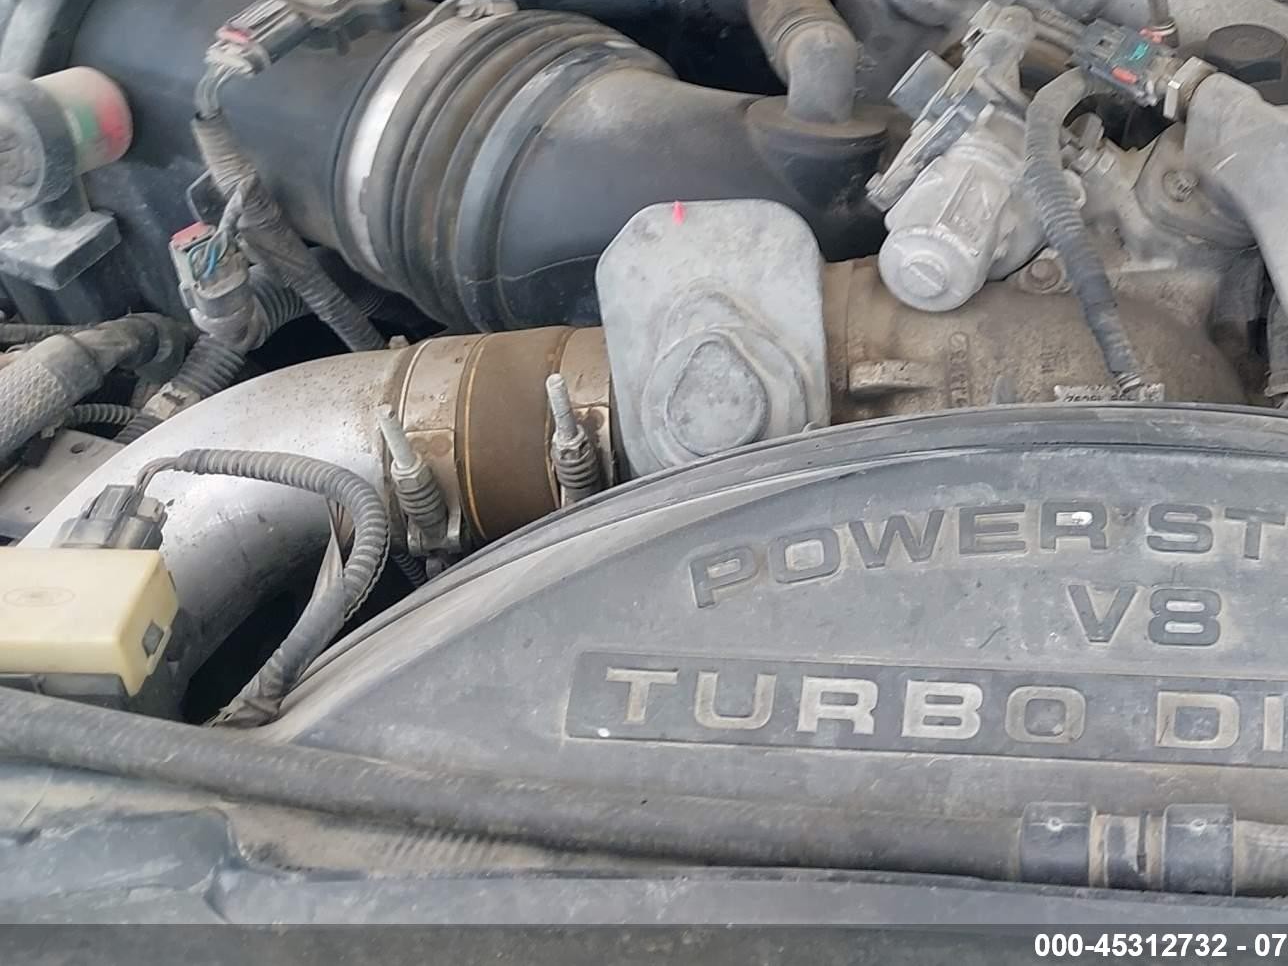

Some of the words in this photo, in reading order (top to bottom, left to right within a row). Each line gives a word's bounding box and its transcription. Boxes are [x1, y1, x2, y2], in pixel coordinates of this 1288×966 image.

[688, 498, 1108, 609] POWER
[1066, 584, 1222, 647] V8
[605, 666, 1087, 744] TURBO
